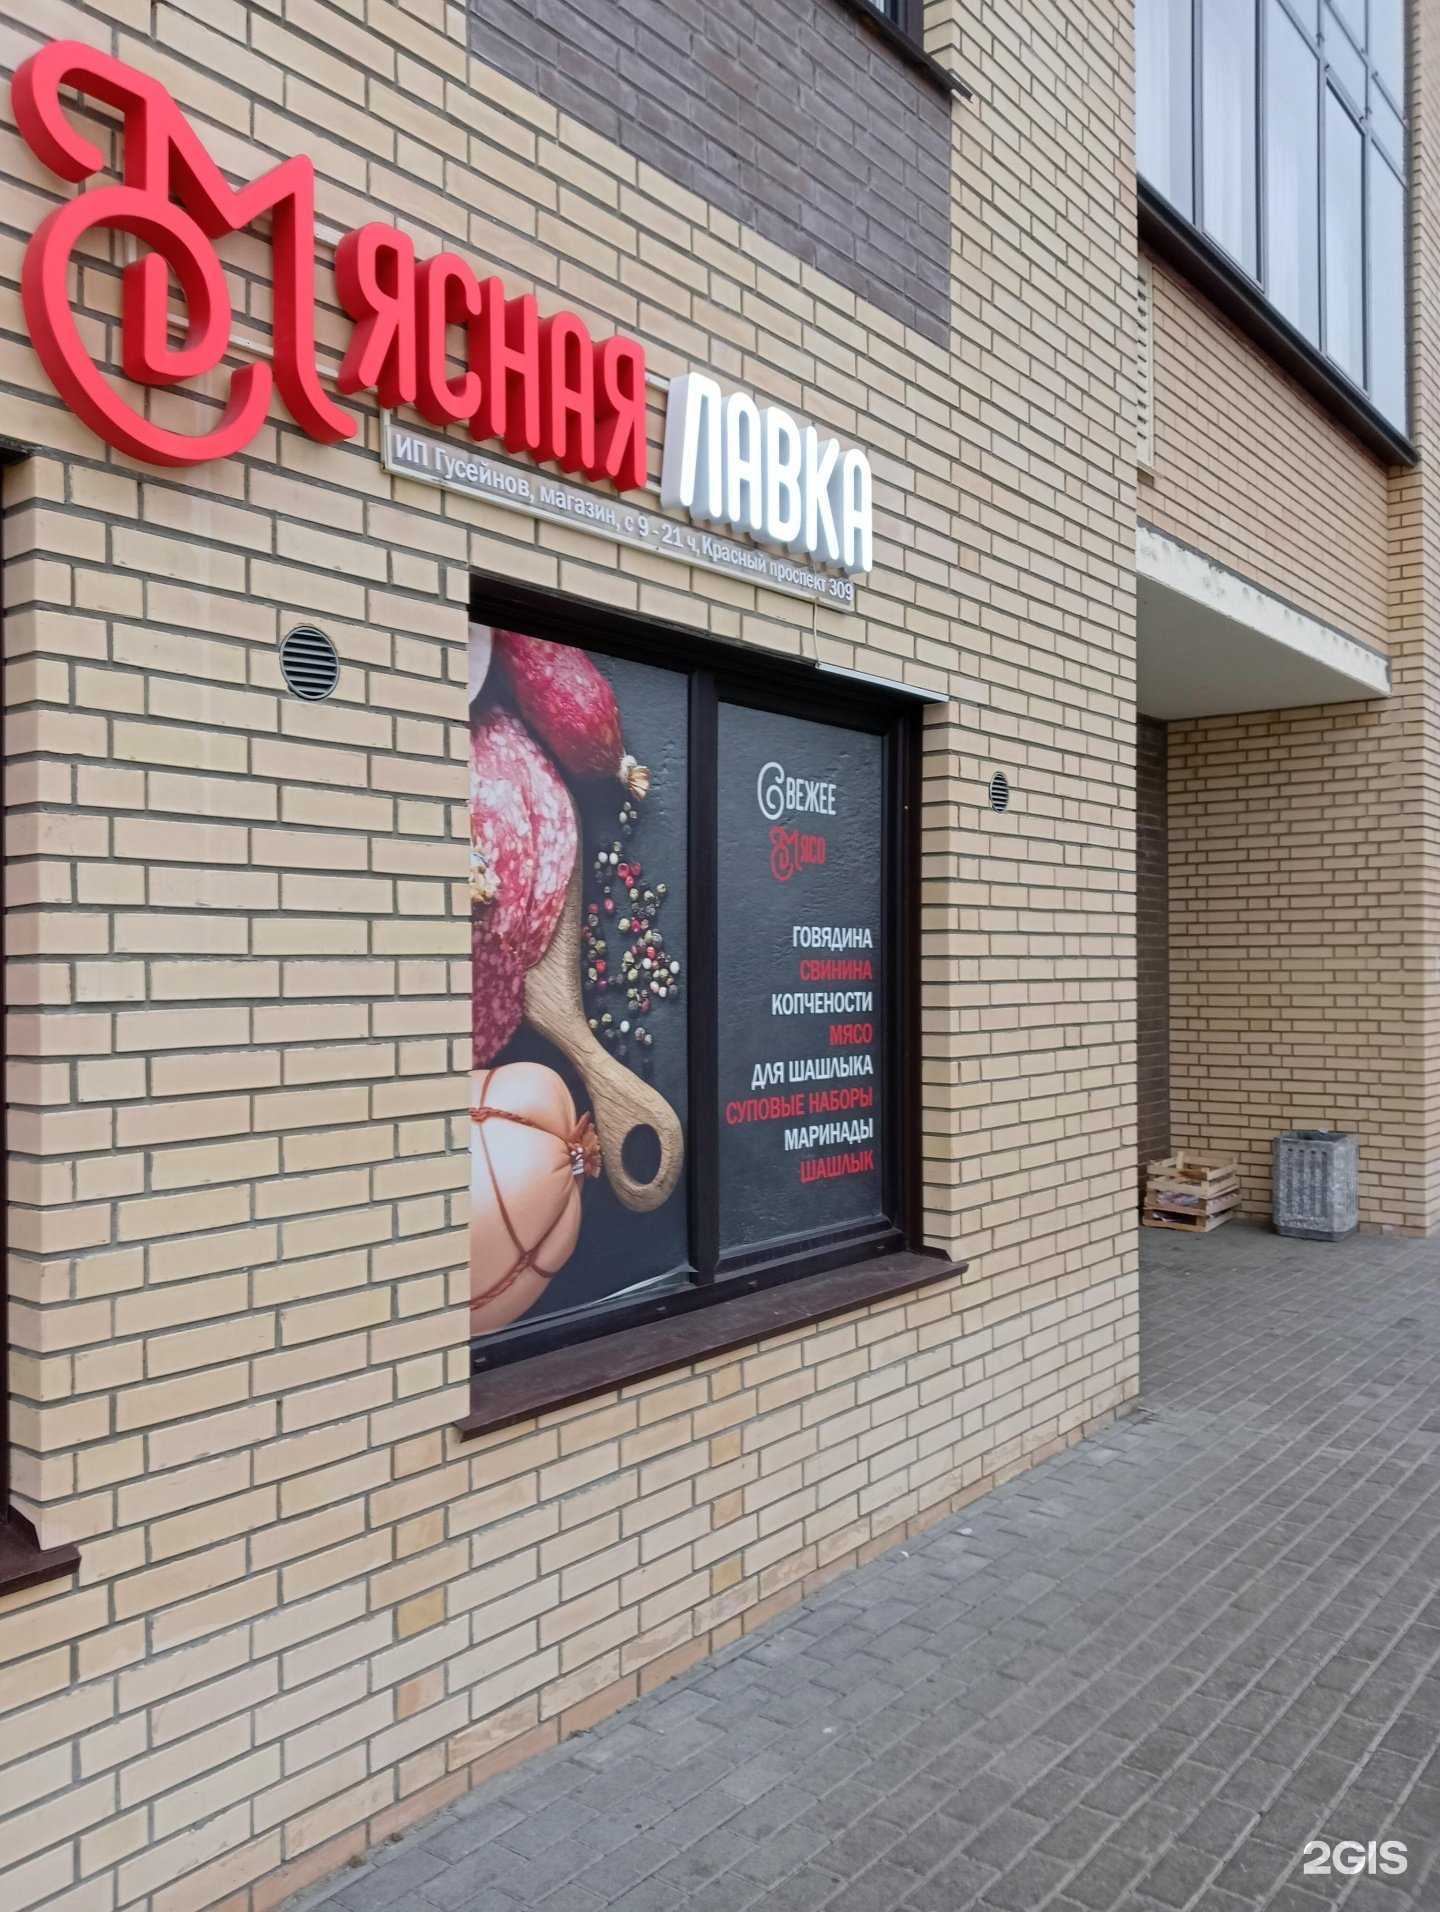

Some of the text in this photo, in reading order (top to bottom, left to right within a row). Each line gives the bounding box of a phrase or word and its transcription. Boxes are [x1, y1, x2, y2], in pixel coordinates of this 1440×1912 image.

[661, 372, 874, 574] ЛАВКА
[395, 434, 429, 466] ИП
[435, 447, 534, 503] Гусейнов,
[540, 487, 621, 532] магазин,
[625, 515, 633, 532] с
[662, 523, 684, 548] 21
[702, 535, 767, 573] Красный
[769, 560, 827, 593] проспект
[829, 577, 854, 601] 309
[793, 926, 873, 951] ГОВЯДИНА
[800, 959, 873, 981] СВИНИНА
[771, 991, 873, 1015] КОПЧЕНОСТИ
[829, 1023, 873, 1045] МЯСО
[751, 1054, 874, 1090] ДЛЯ ШАШЛЫКА
[726, 1087, 873, 1124] СУПОВЫЕ НАБОРЫ
[784, 1118, 873, 1151] МАРИНАДЫ
[800, 1152, 873, 1183] ШАШЛЫК
